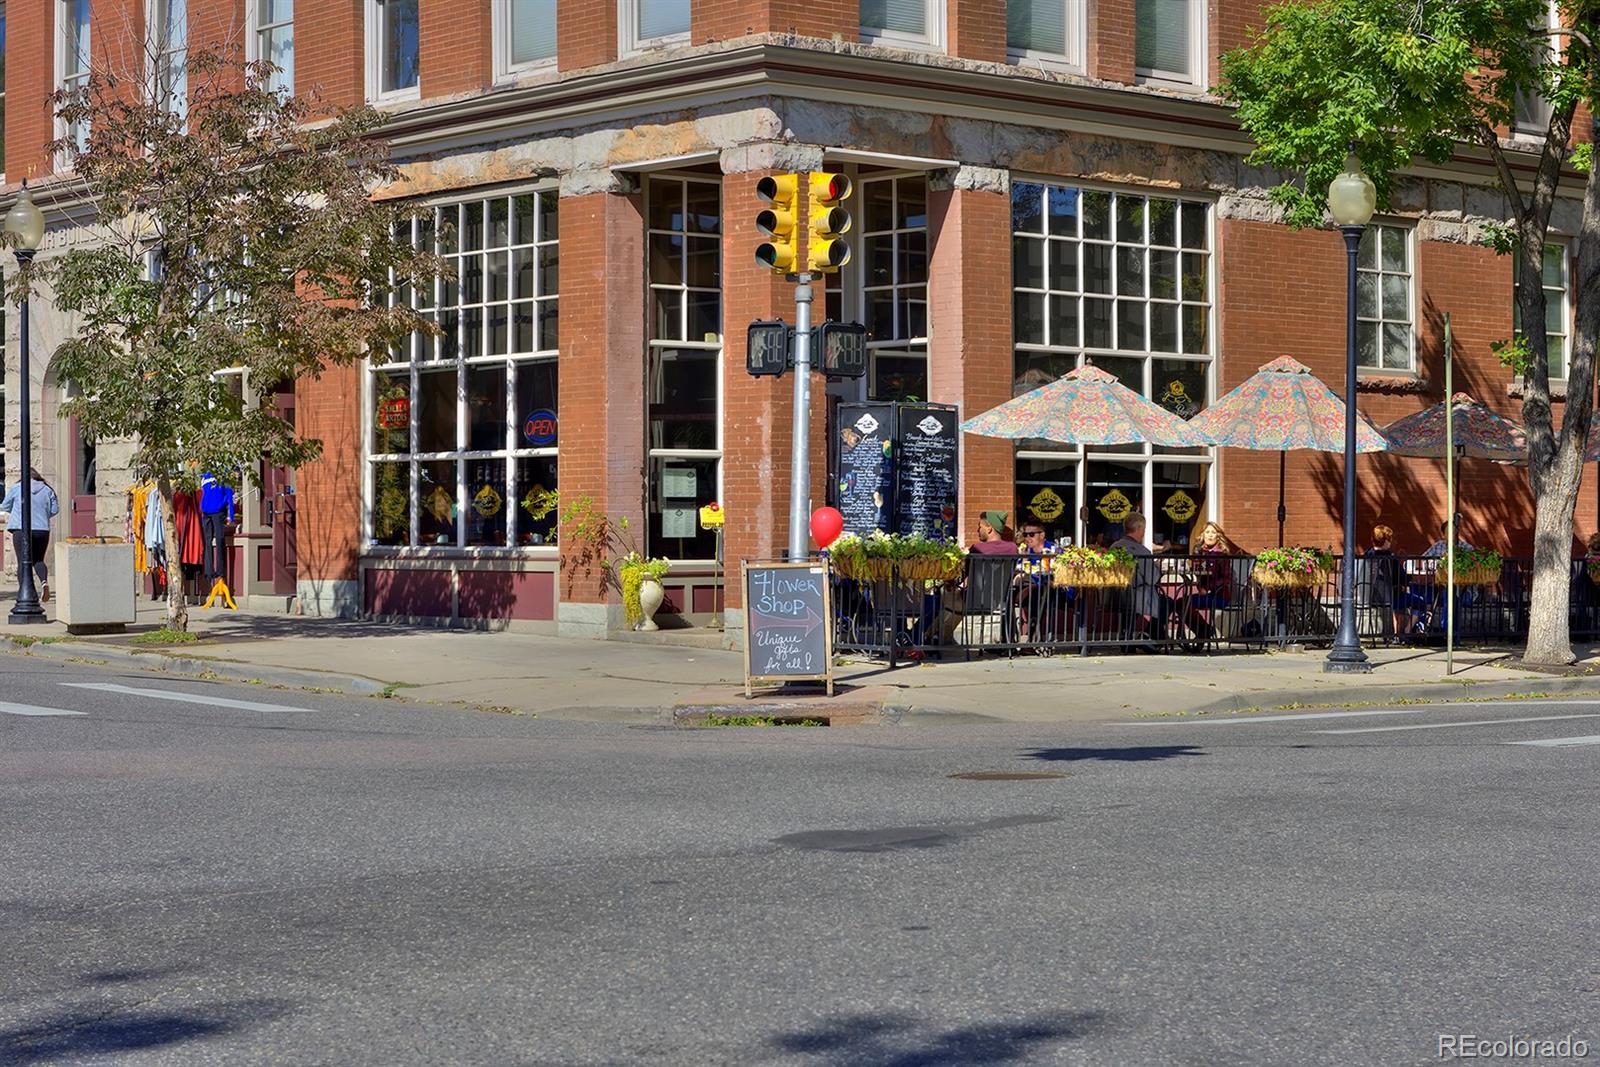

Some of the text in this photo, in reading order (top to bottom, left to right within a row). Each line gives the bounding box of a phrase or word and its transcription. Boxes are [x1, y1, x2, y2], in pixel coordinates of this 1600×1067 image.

[526, 420, 556, 436] OPEN
[757, 595, 805, 615] Shop
[756, 630, 802, 648] Unique
[774, 643, 801, 661] gifts
[764, 658, 781, 674] for
